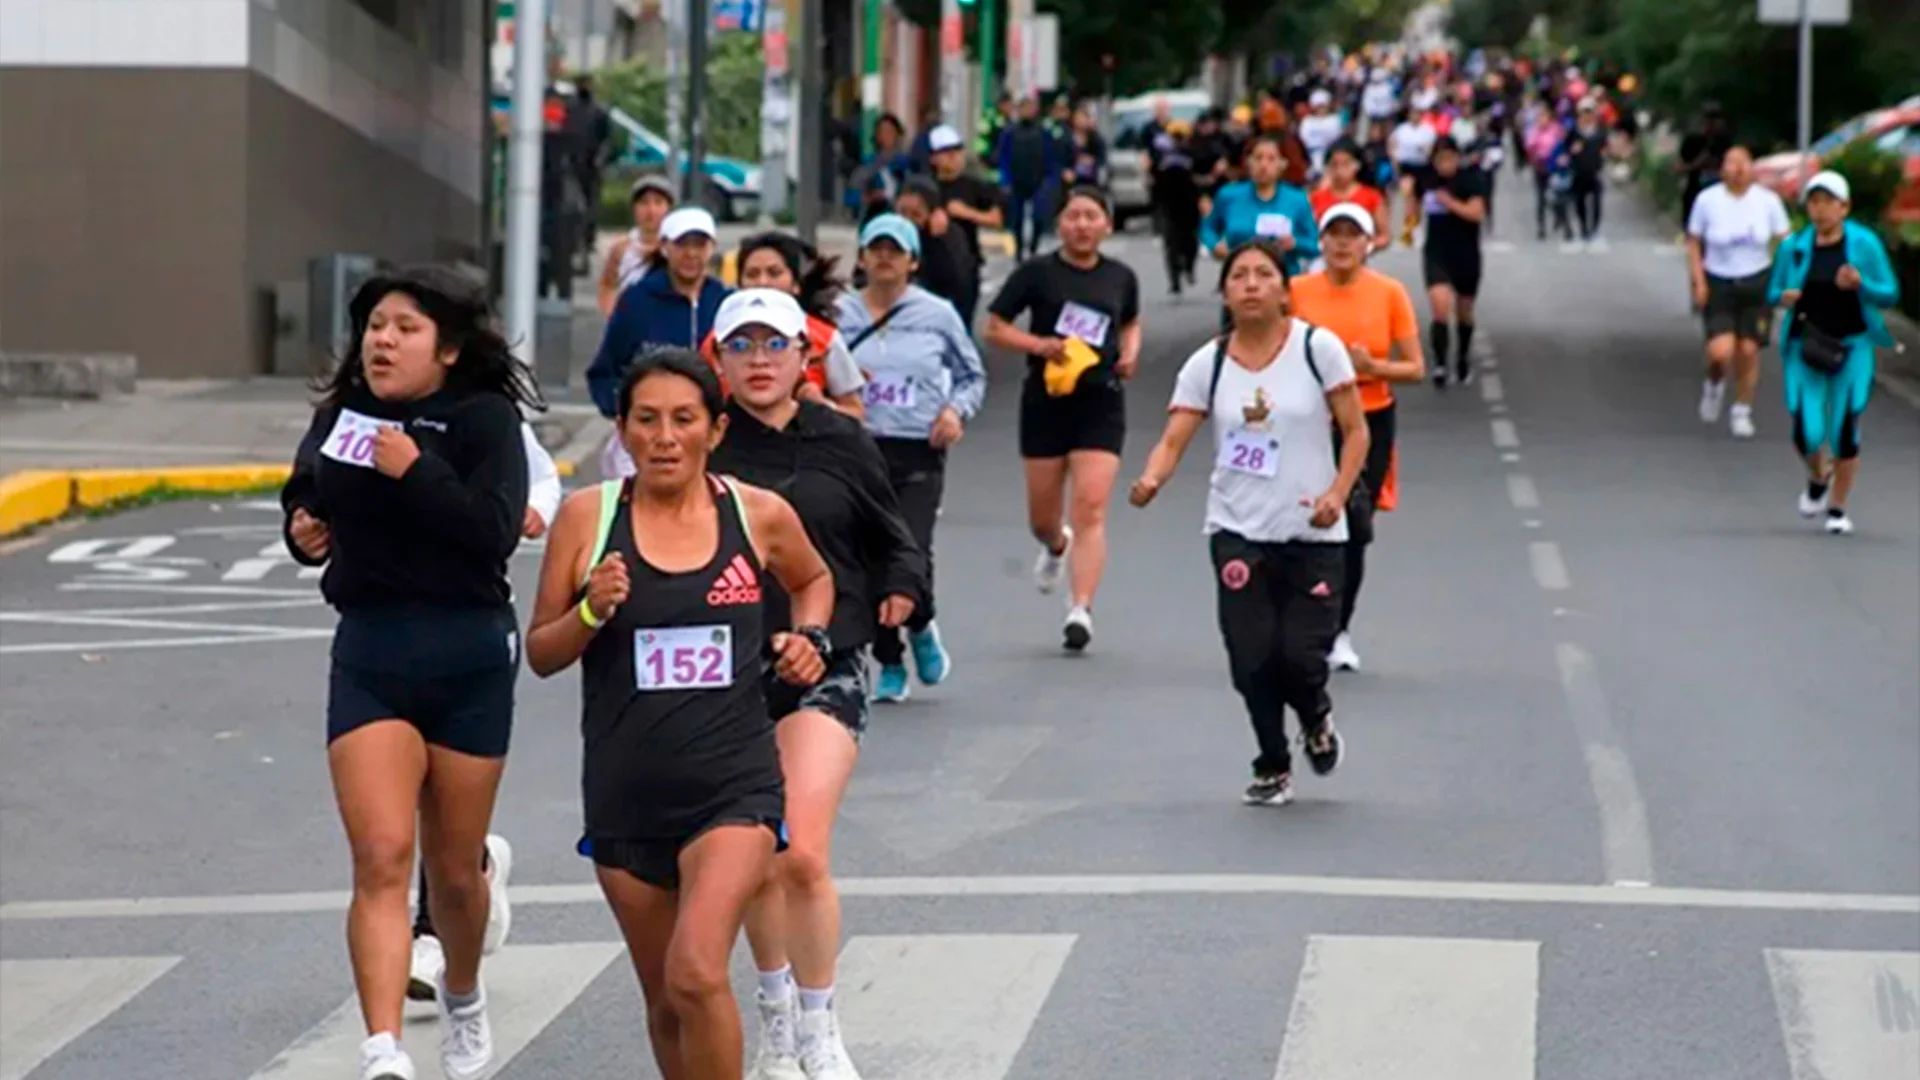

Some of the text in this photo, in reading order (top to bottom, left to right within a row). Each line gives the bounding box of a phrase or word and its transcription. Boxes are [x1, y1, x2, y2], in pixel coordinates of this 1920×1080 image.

[337, 429, 377, 462] 10
[1231, 443, 1266, 471] 28
[706, 585, 761, 606] adida
[645, 646, 725, 685] 152
